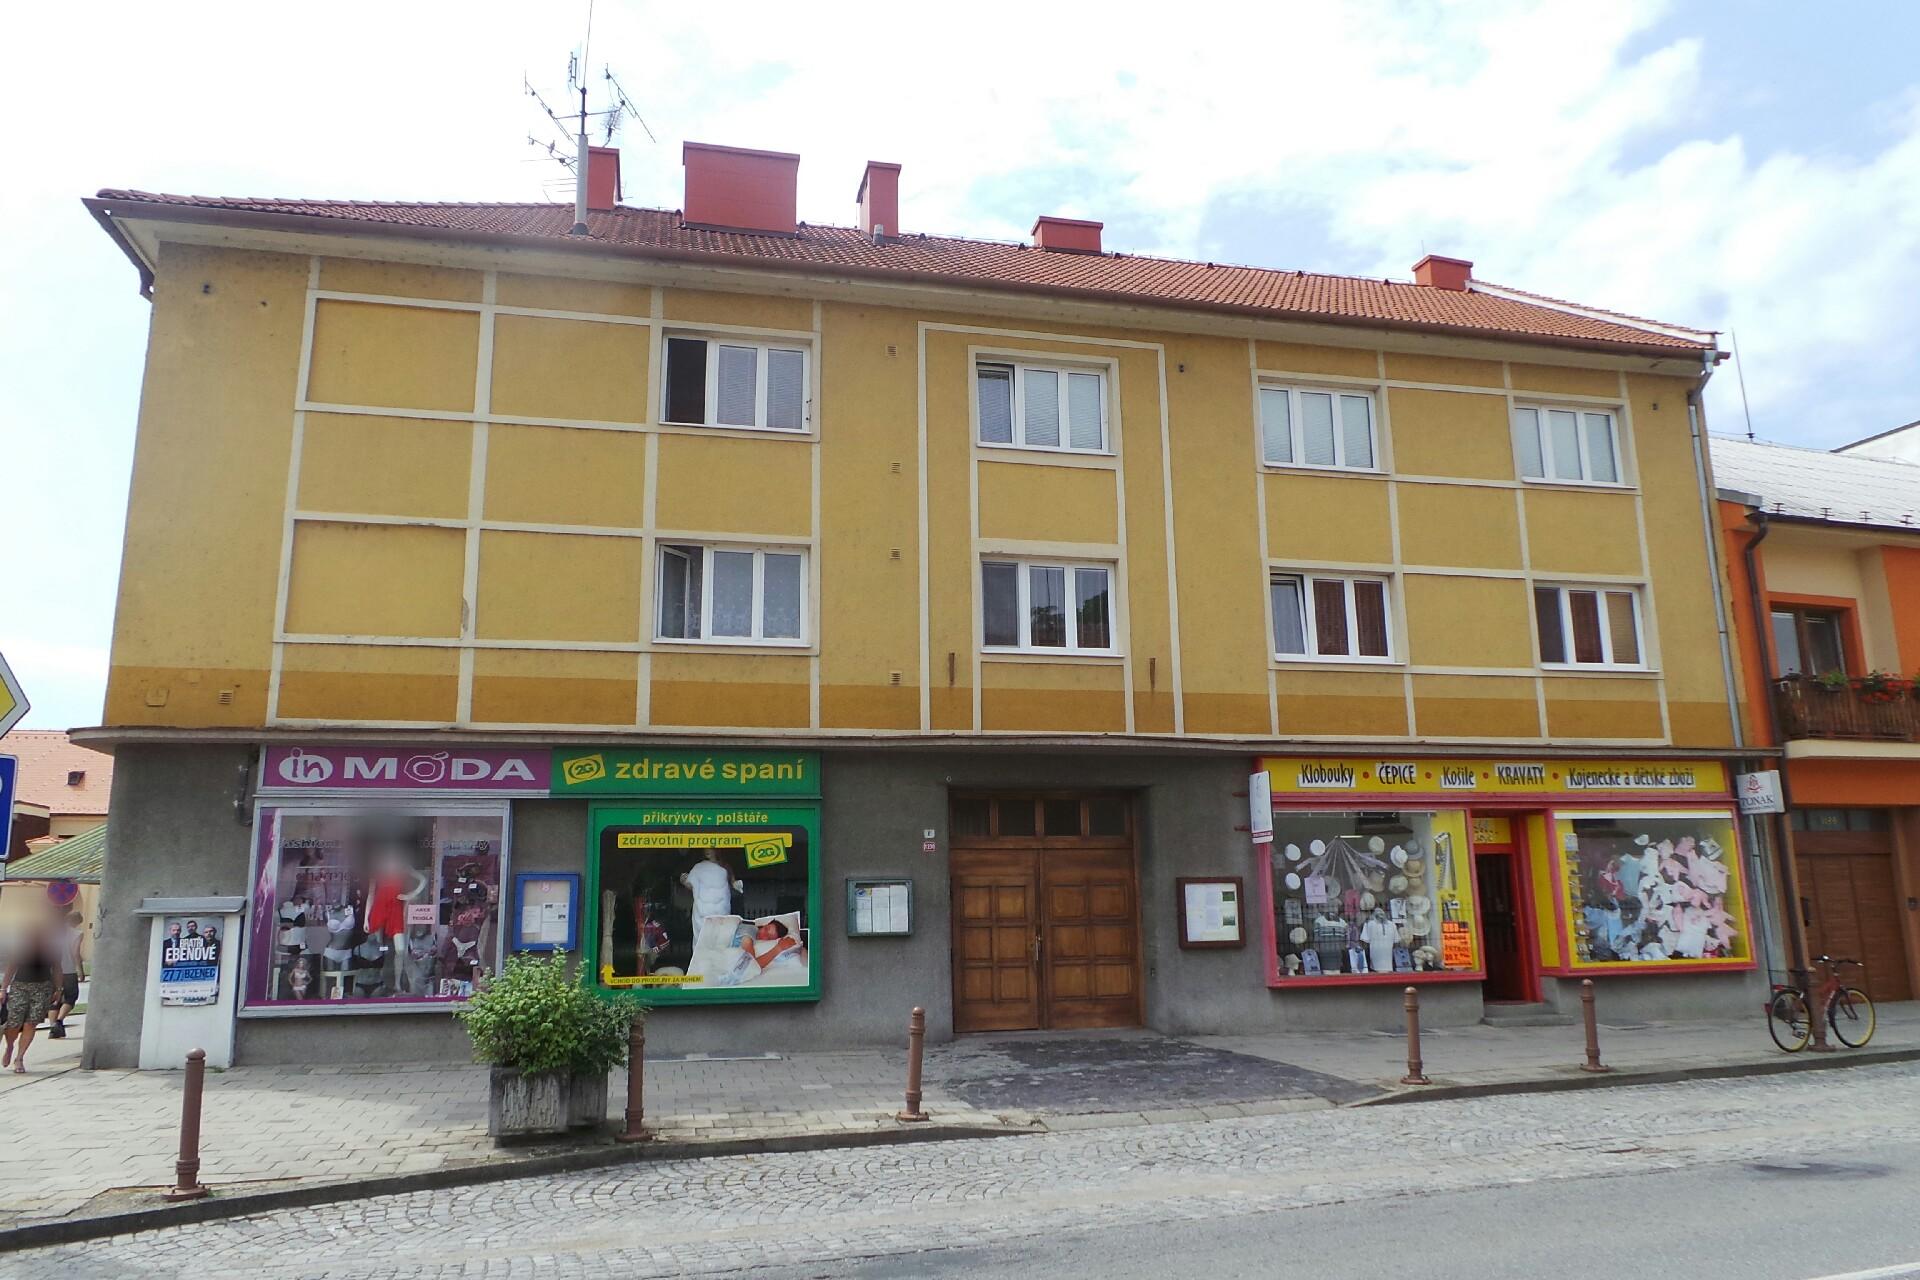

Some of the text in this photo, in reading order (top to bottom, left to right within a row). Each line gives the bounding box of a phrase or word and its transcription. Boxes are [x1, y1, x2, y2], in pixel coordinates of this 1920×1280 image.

[615, 758, 715, 780] zdravé
[722, 758, 804, 784] spaní
[1301, 761, 1695, 789] Klobouky ČEPICE Košile KRAVATY Kojenecké a dětské zboží
[642, 811, 703, 826] přikrývky
[716, 811, 769, 825] polštáře
[622, 834, 742, 848] zdravotní program
[757, 847, 776, 859] 2G
[166, 944, 216, 961] EBENOVÉ
[185, 968, 216, 978] BZENEC
